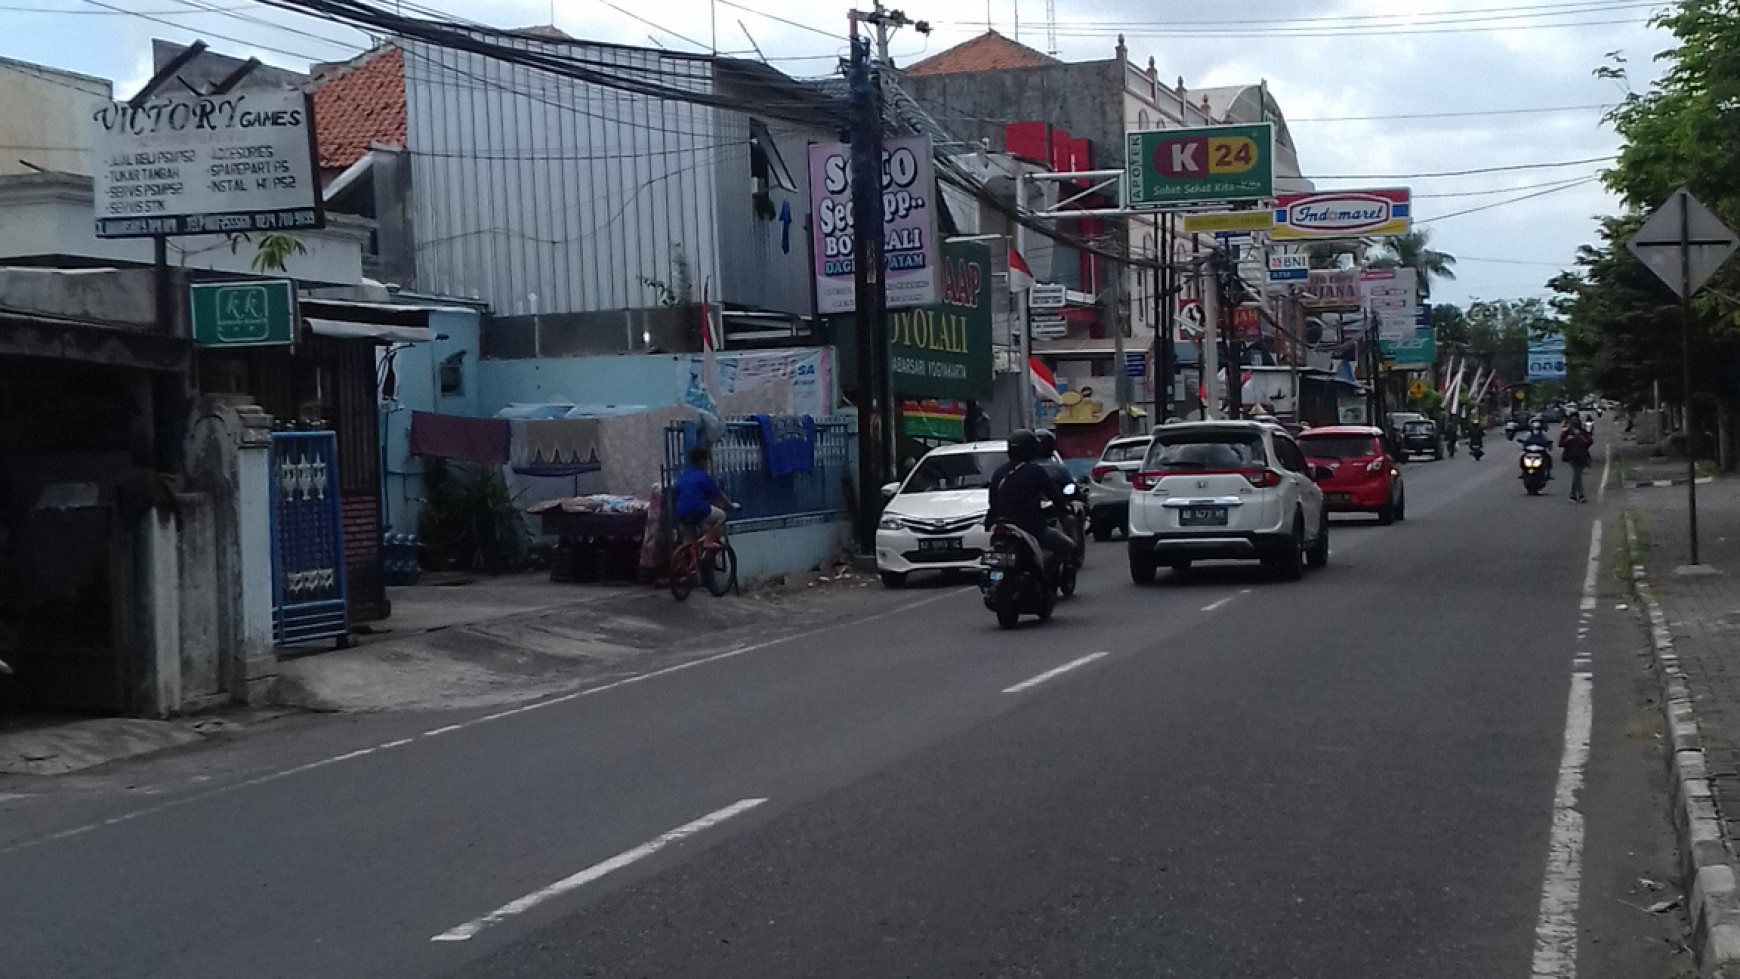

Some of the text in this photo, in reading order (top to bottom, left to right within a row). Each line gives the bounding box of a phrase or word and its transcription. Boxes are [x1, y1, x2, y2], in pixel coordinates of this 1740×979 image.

[93, 96, 301, 135] VICTORY GAMES
[1130, 135, 1143, 200] APOTEK
[1171, 142, 1253, 172] K 24
[1283, 255, 1306, 267] BNI
